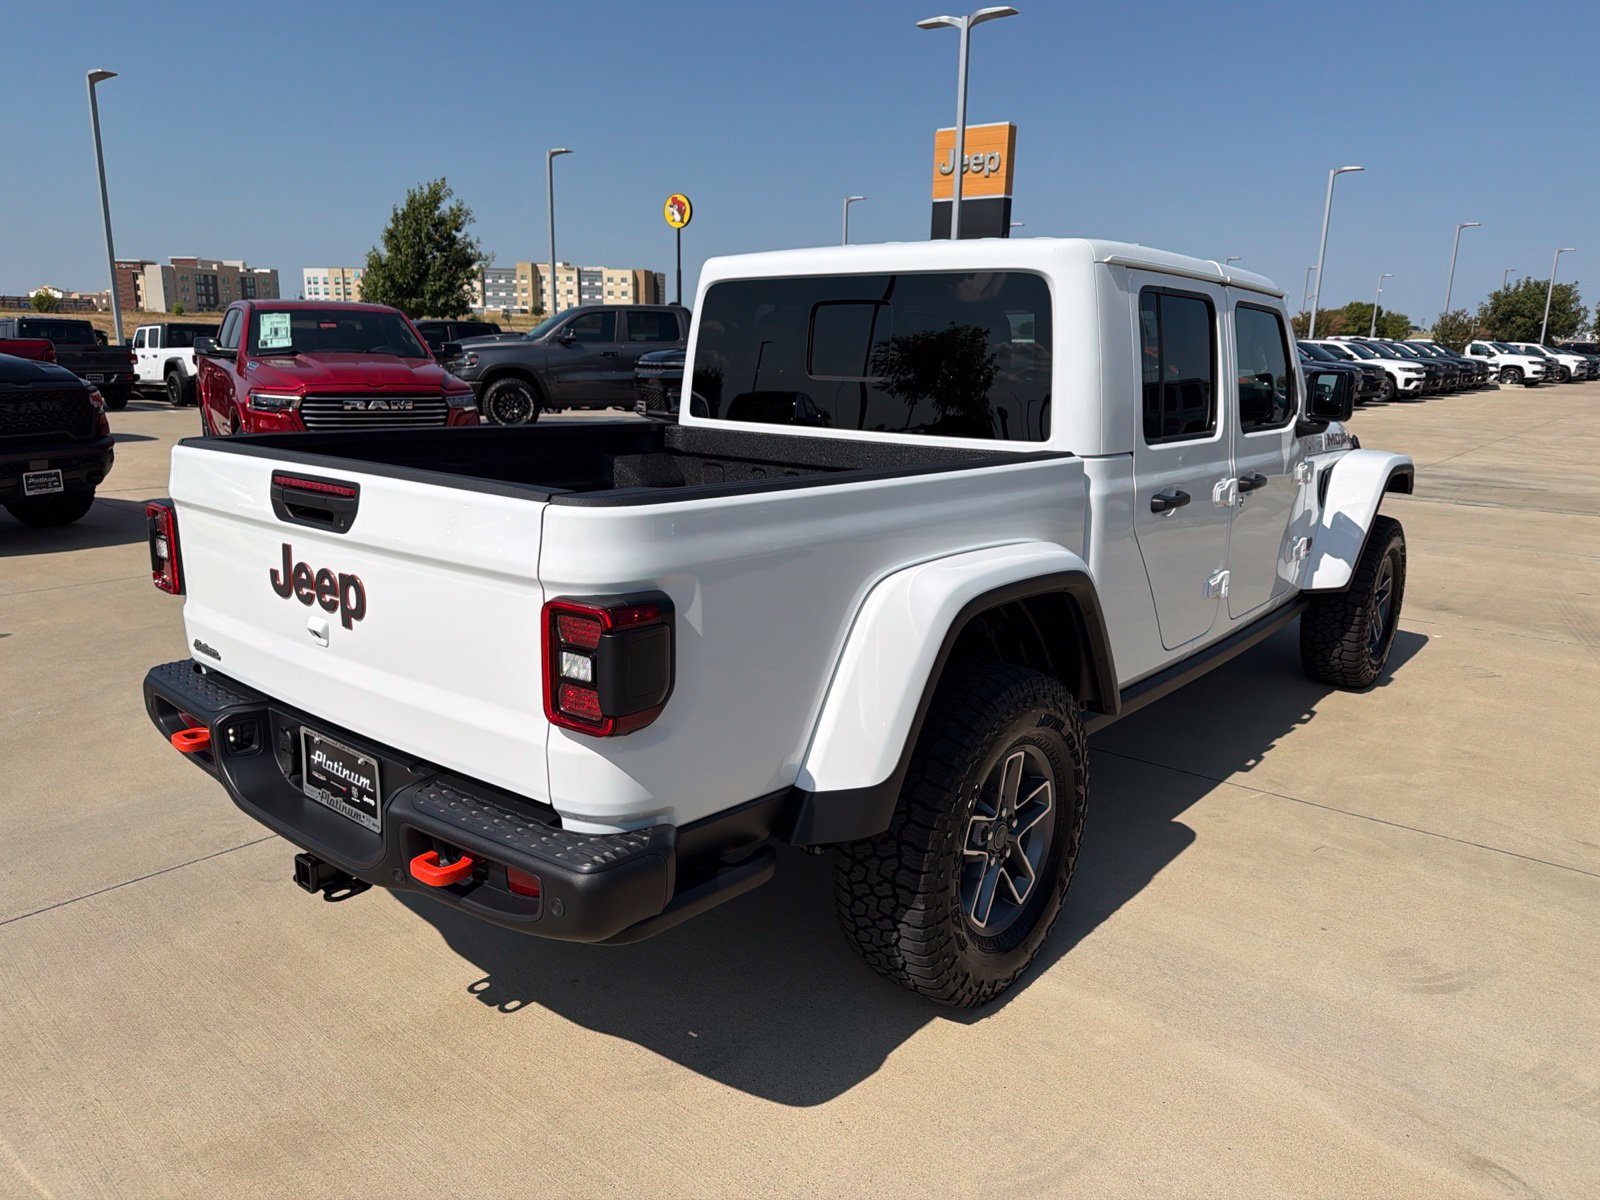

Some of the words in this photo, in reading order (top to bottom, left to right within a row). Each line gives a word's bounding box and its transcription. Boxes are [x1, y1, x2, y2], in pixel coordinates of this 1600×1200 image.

[343, 400, 414, 410] RAM
[269, 542, 367, 631] Jeep
[310, 750, 374, 792] Platinum
[320, 790, 364, 824] Platinum
